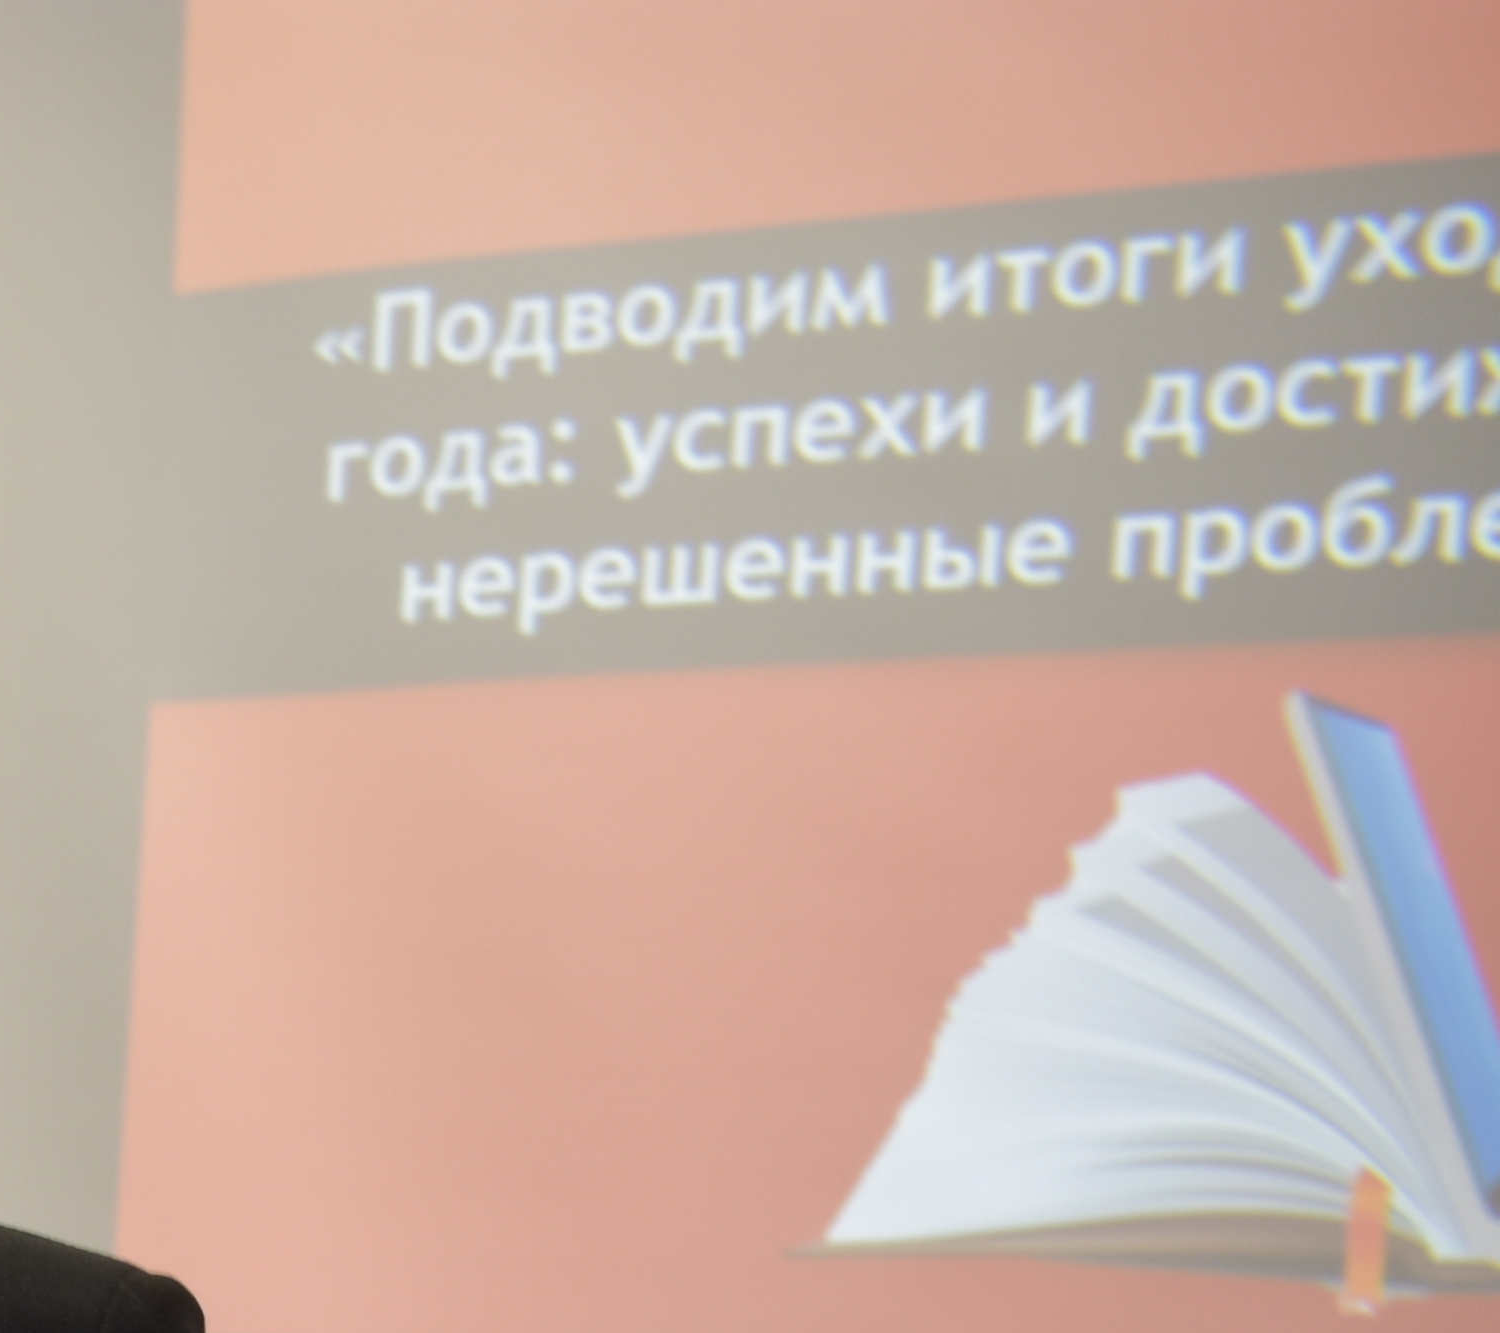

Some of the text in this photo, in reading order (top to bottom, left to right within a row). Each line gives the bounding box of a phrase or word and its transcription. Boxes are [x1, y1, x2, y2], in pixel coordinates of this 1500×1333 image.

[313, 199, 1500, 379] «Подводим итоги ухо
[326, 417, 576, 512] года:
[615, 386, 987, 498] успехи
[1026, 379, 1092, 446] и
[399, 520, 1071, 636] нерешенные
